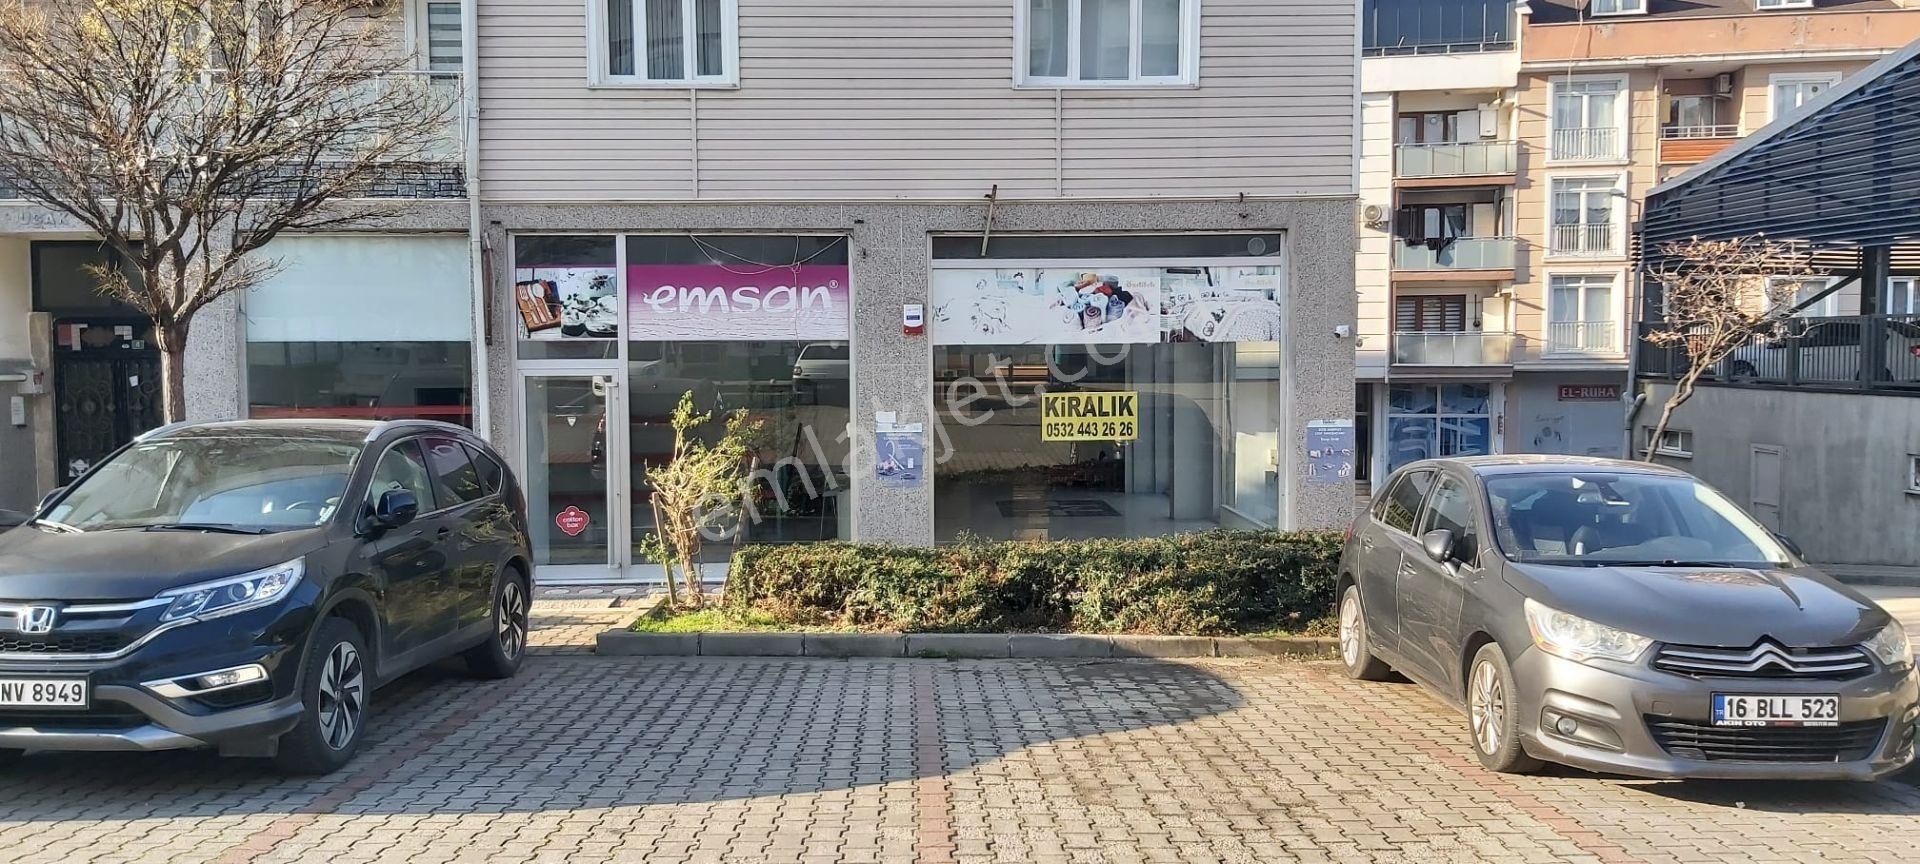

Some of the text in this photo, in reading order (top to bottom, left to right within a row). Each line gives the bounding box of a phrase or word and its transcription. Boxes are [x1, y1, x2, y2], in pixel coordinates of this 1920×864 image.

[1561, 387, 1616, 398] EL-RUHA
[1046, 421, 1133, 437] 0532 443 26 26
[32, 683, 83, 702] 8949
[1727, 698, 1837, 718] 16 BLL 523
